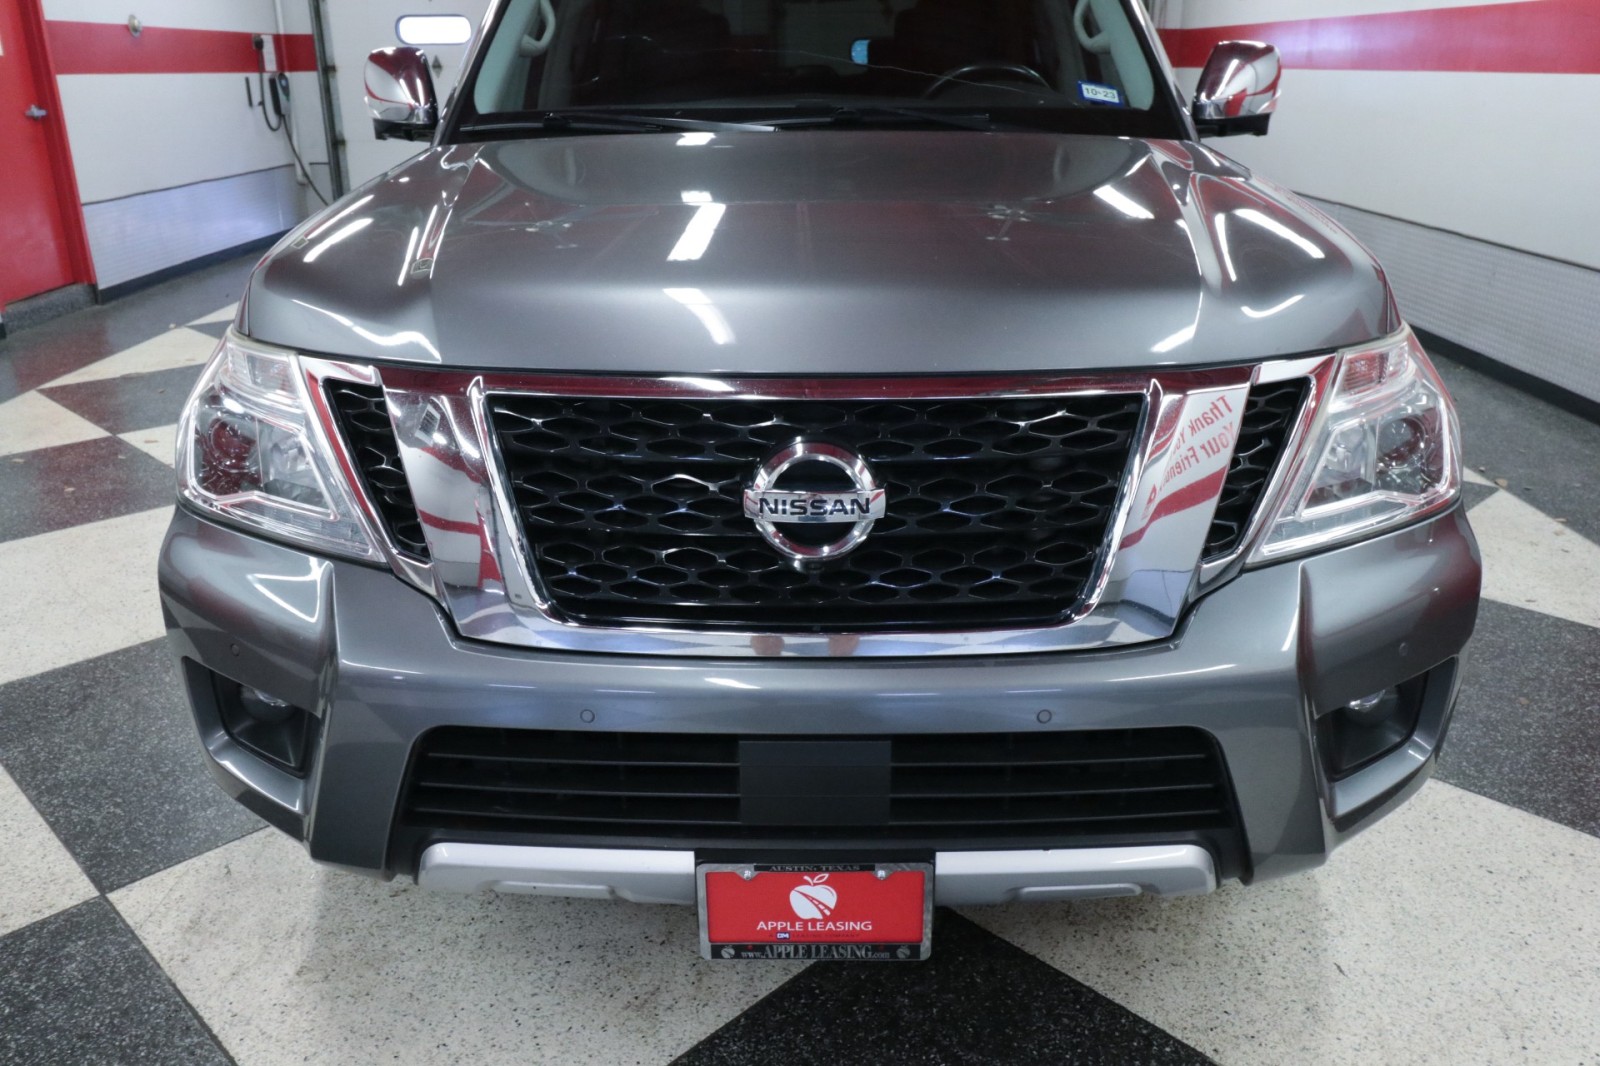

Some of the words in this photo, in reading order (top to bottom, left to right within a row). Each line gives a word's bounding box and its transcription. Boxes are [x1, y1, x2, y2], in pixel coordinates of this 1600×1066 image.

[759, 498, 870, 515] NISSAN
[756, 921, 804, 931] APPLE
[807, 921, 873, 931] LEASING
